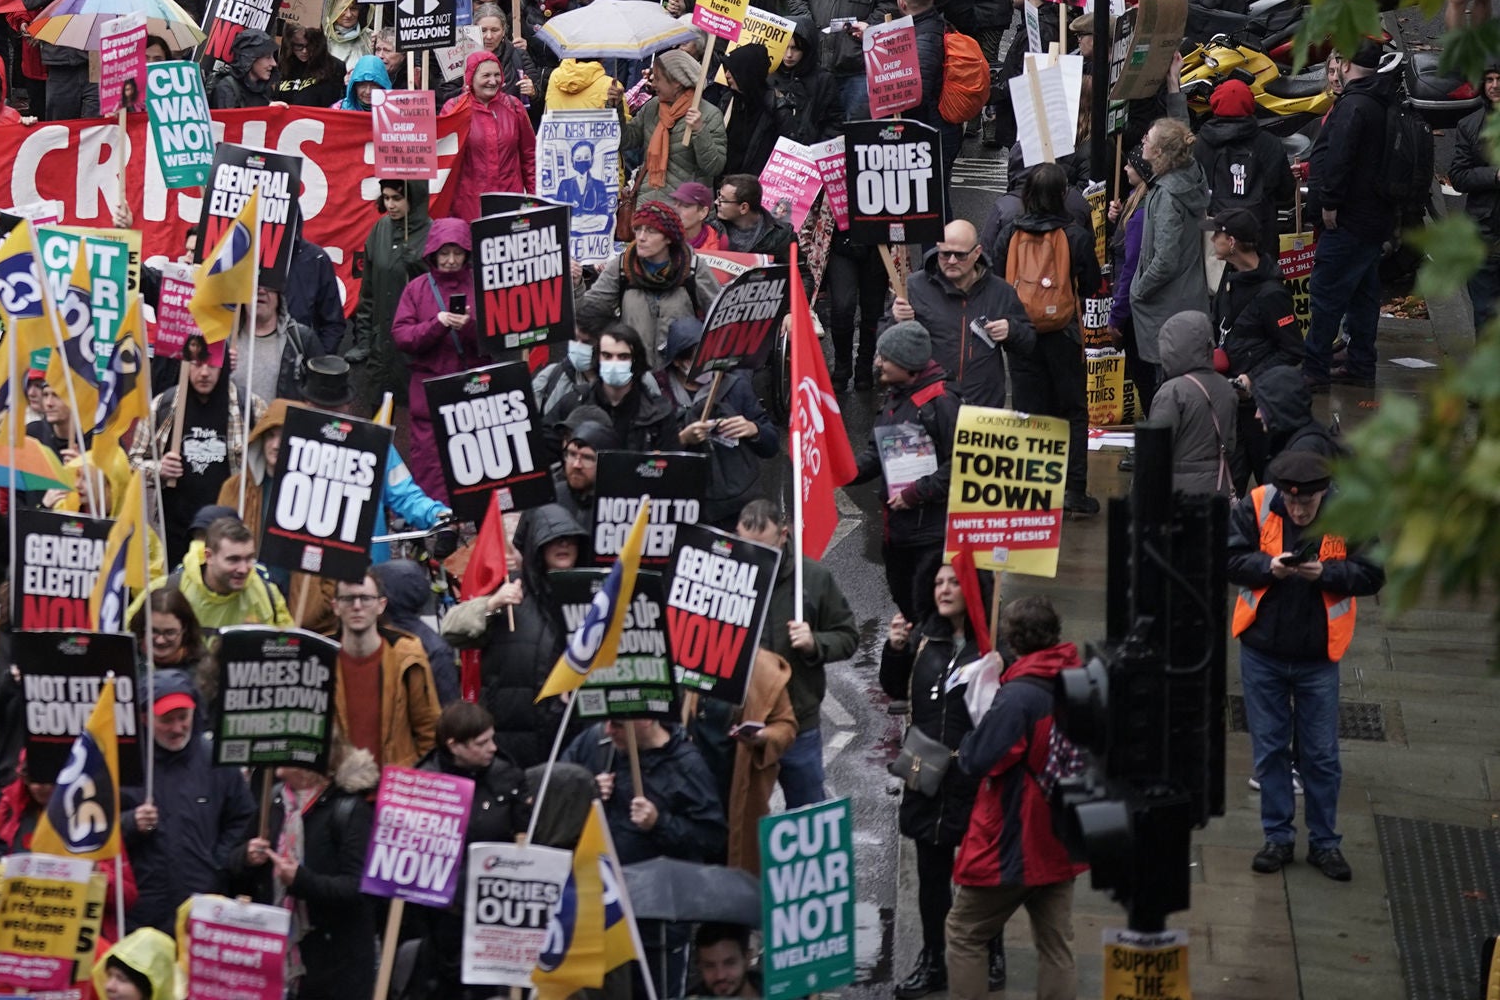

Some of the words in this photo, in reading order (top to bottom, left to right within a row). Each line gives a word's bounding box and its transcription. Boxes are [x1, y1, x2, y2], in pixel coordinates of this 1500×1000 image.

[400, 13, 433, 30] WAGES
[435, 12, 452, 25] NOT
[711, 0, 730, 13] here
[400, 25, 451, 41] WEAPONS
[382, 133, 427, 142] RENEWABLES
[393, 123, 415, 131] CHEAP
[543, 122, 559, 139] PAY
[565, 122, 585, 137] NHS
[385, 156, 398, 164] FOR
[438, 390, 529, 435] TORIES
[446, 421, 535, 487] OUT
[956, 428, 1019, 457] BRING
[1025, 436, 1068, 456] THE
[955, 451, 1065, 485] TORIES
[961, 480, 1052, 512] DOWN
[953, 519, 985, 531] UNITE
[987, 518, 1008, 530] THE
[1010, 515, 1056, 529] STRIKES
[769, 808, 847, 862] CUT
[768, 853, 849, 902] WAR
[771, 899, 847, 946] NOT
[772, 935, 849, 971] WELFARE
